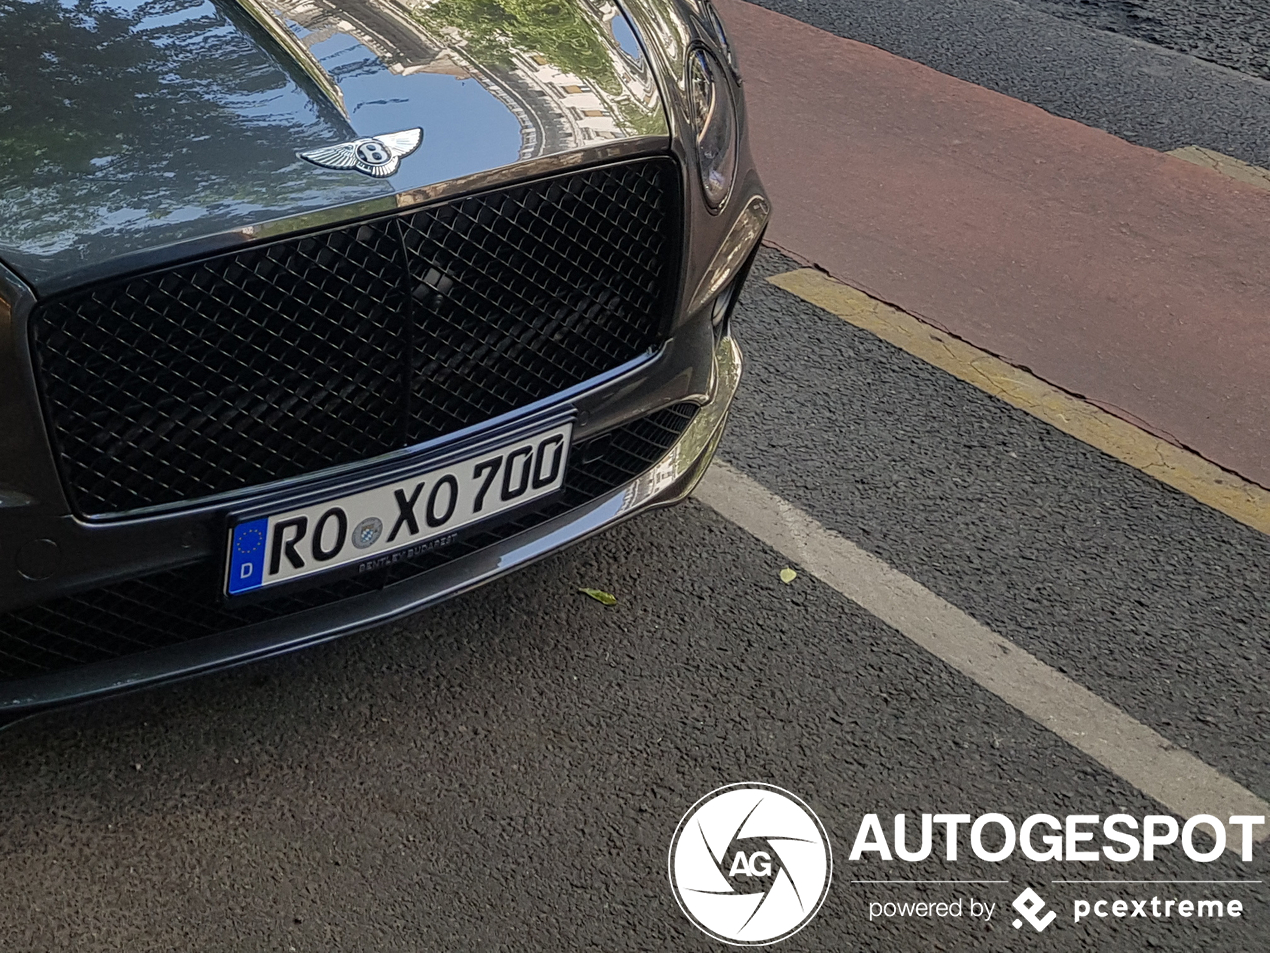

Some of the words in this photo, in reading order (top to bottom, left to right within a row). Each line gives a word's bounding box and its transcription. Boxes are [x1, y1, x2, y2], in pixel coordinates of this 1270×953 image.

[268, 506, 348, 576] RO
[386, 473, 459, 543] XO
[472, 433, 564, 514] 700
[240, 562, 253, 579] D
[358, 550, 406, 574] BENTLEY
[406, 533, 458, 558] BUDAPEST
